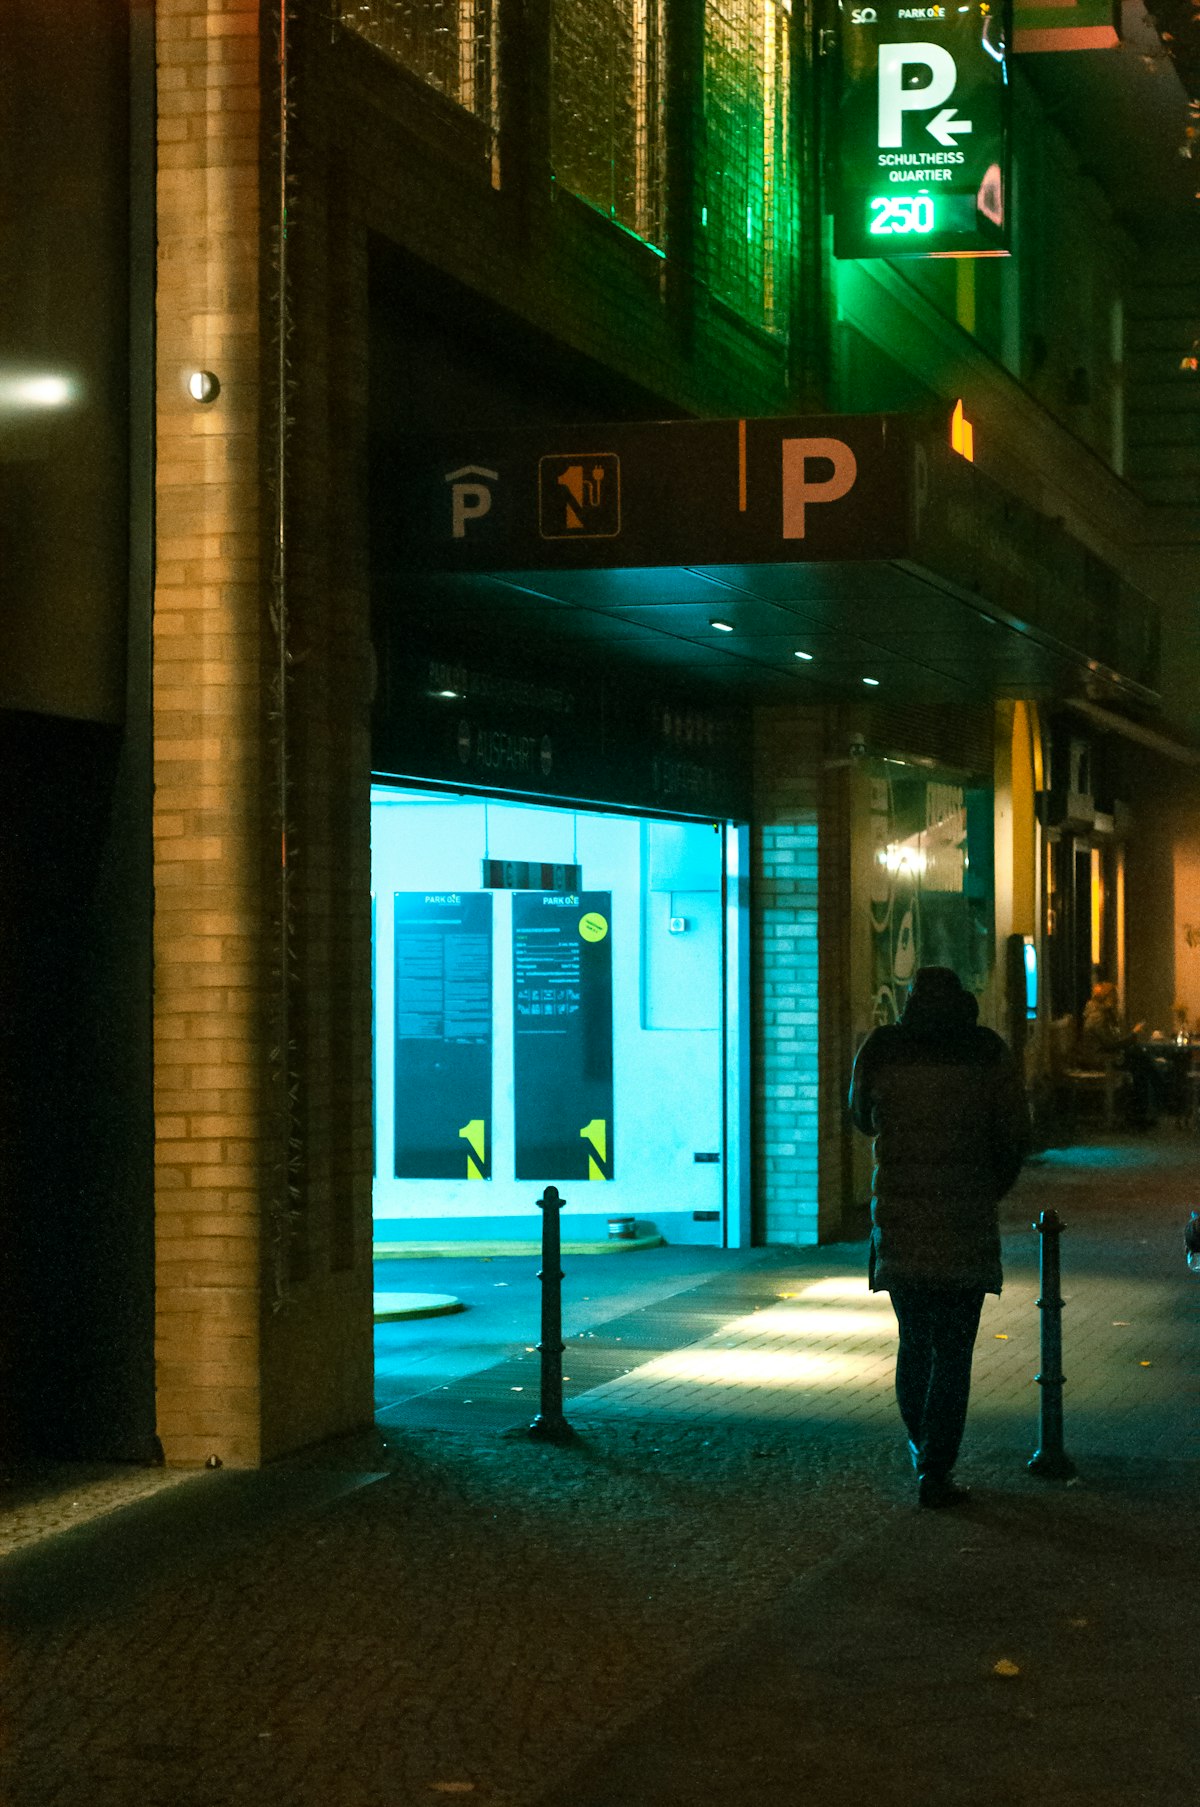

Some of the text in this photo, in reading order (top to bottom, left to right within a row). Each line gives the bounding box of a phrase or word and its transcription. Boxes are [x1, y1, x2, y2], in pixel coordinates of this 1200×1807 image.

[898, 8, 926, 19] PARK
[878, 42, 957, 148] P
[878, 152, 965, 166] SCHULTHEISS
[889, 169, 953, 183] QUARTIER
[869, 196, 935, 234] 250
[782, 437, 858, 540] P
[451, 482, 493, 539] P
[425, 896, 446, 904] PARK
[543, 896, 565, 905] PARK
